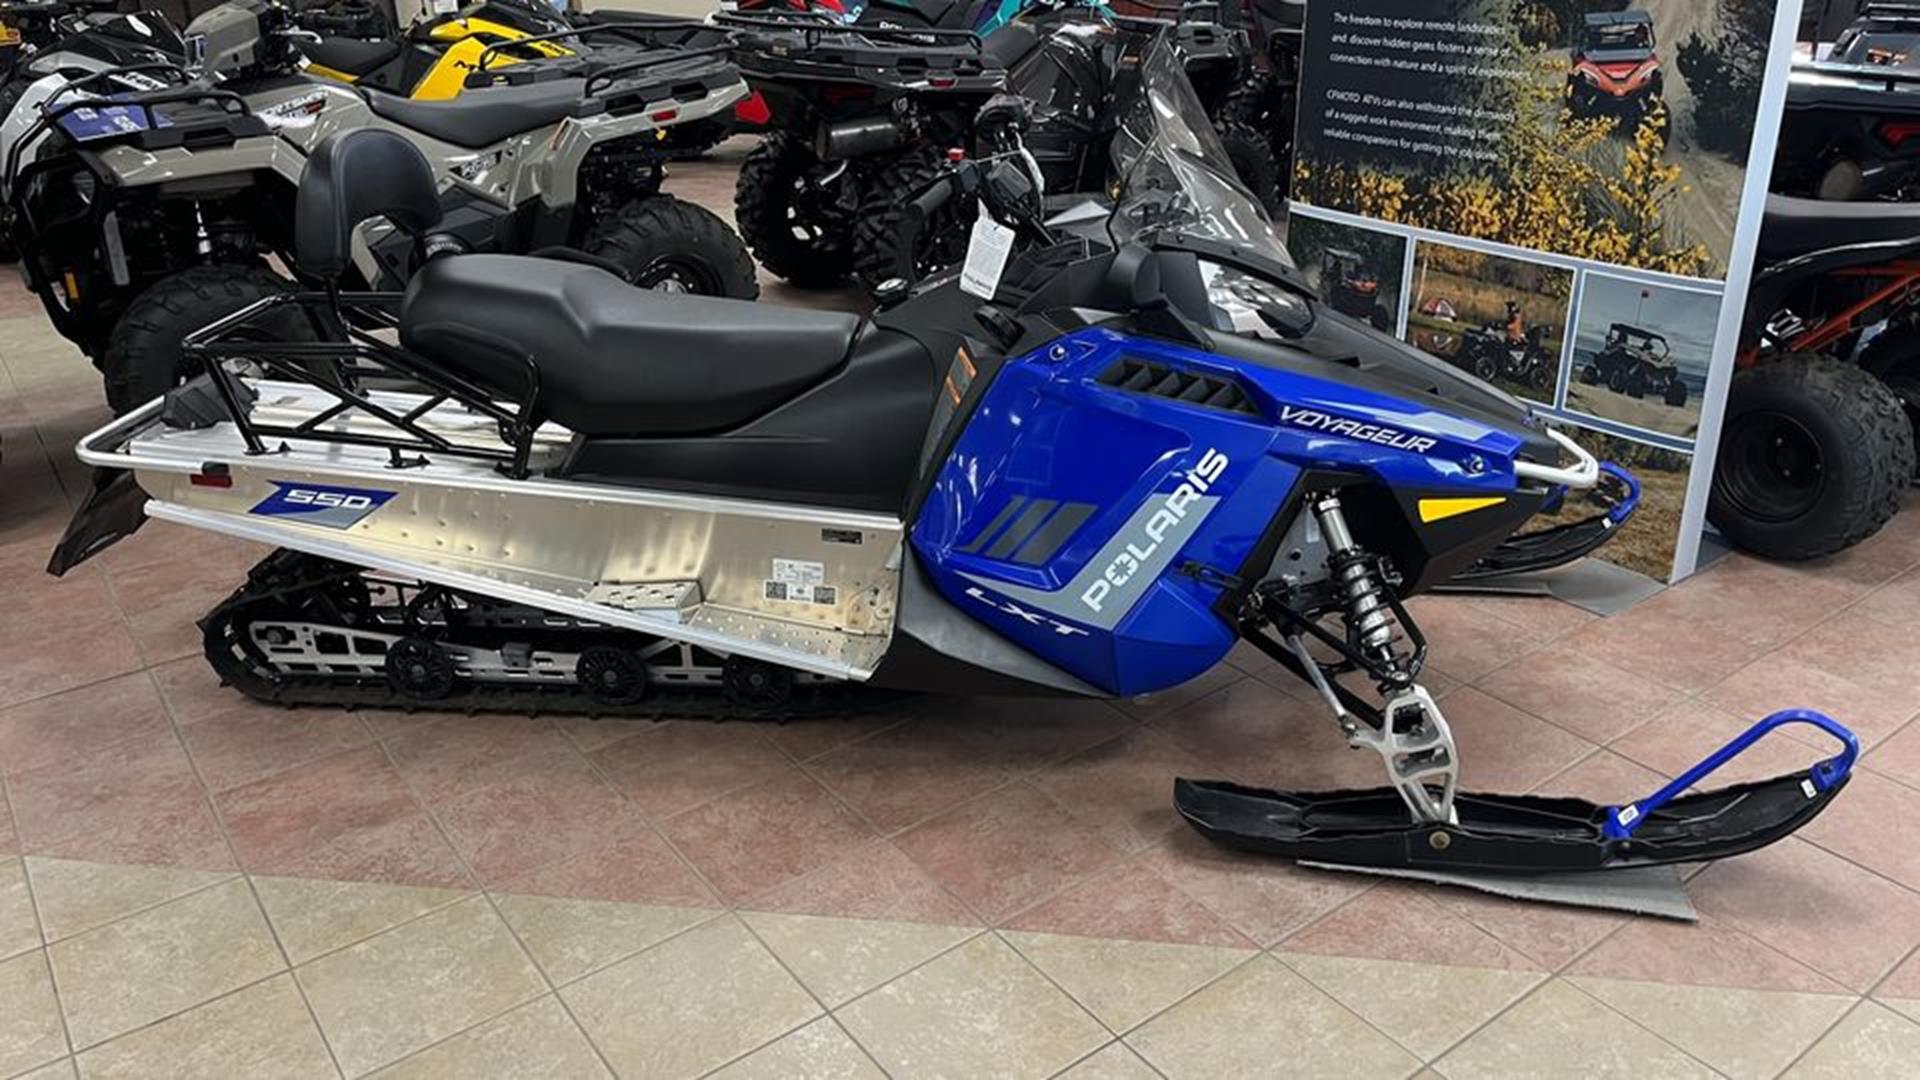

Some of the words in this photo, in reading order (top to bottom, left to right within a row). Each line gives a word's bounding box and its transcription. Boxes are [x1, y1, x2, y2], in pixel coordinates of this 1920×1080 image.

[1349, 13, 1381, 26] freedom
[1383, 17, 1392, 27] to
[1393, 18, 1423, 30] explore
[1424, 21, 1455, 32] remote
[1331, 34, 1347, 43] and
[1349, 34, 1381, 46] discover
[1382, 37, 1411, 49] hidden
[1412, 41, 1434, 52] gems
[1437, 40, 1464, 53] fosters
[1329, 53, 1372, 65] connection
[1374, 57, 1390, 67] with
[1392, 60, 1419, 71] nature
[1420, 62, 1437, 72] and
[1445, 65, 1466, 76] spirit
[1468, 65, 1479, 75] of
[1326, 89, 1361, 103] CFMOTO
[1362, 94, 1380, 106] ATVs
[1382, 98, 1397, 107] can
[1398, 100, 1414, 111] also
[1416, 102, 1457, 116] withstand
[1458, 105, 1472, 118] the
[1325, 108, 1334, 118] of
[1340, 112, 1368, 124] rugged
[1369, 116, 1387, 126] work
[1390, 119, 1442, 135] environment,
[1443, 125, 1475, 140] making
[1324, 128, 1350, 140] reliable
[1352, 133, 1398, 147] companions
[1400, 138, 1411, 149] for
[1412, 142, 1442, 156] getting
[1443, 145, 1458, 156] the
[1458, 148, 1473, 159] job
[1281, 405, 1437, 453] VOYAGEUR
[283, 488, 372, 510] 550
[1081, 447, 1229, 613] POLARIS
[965, 586, 1090, 636] LXT
